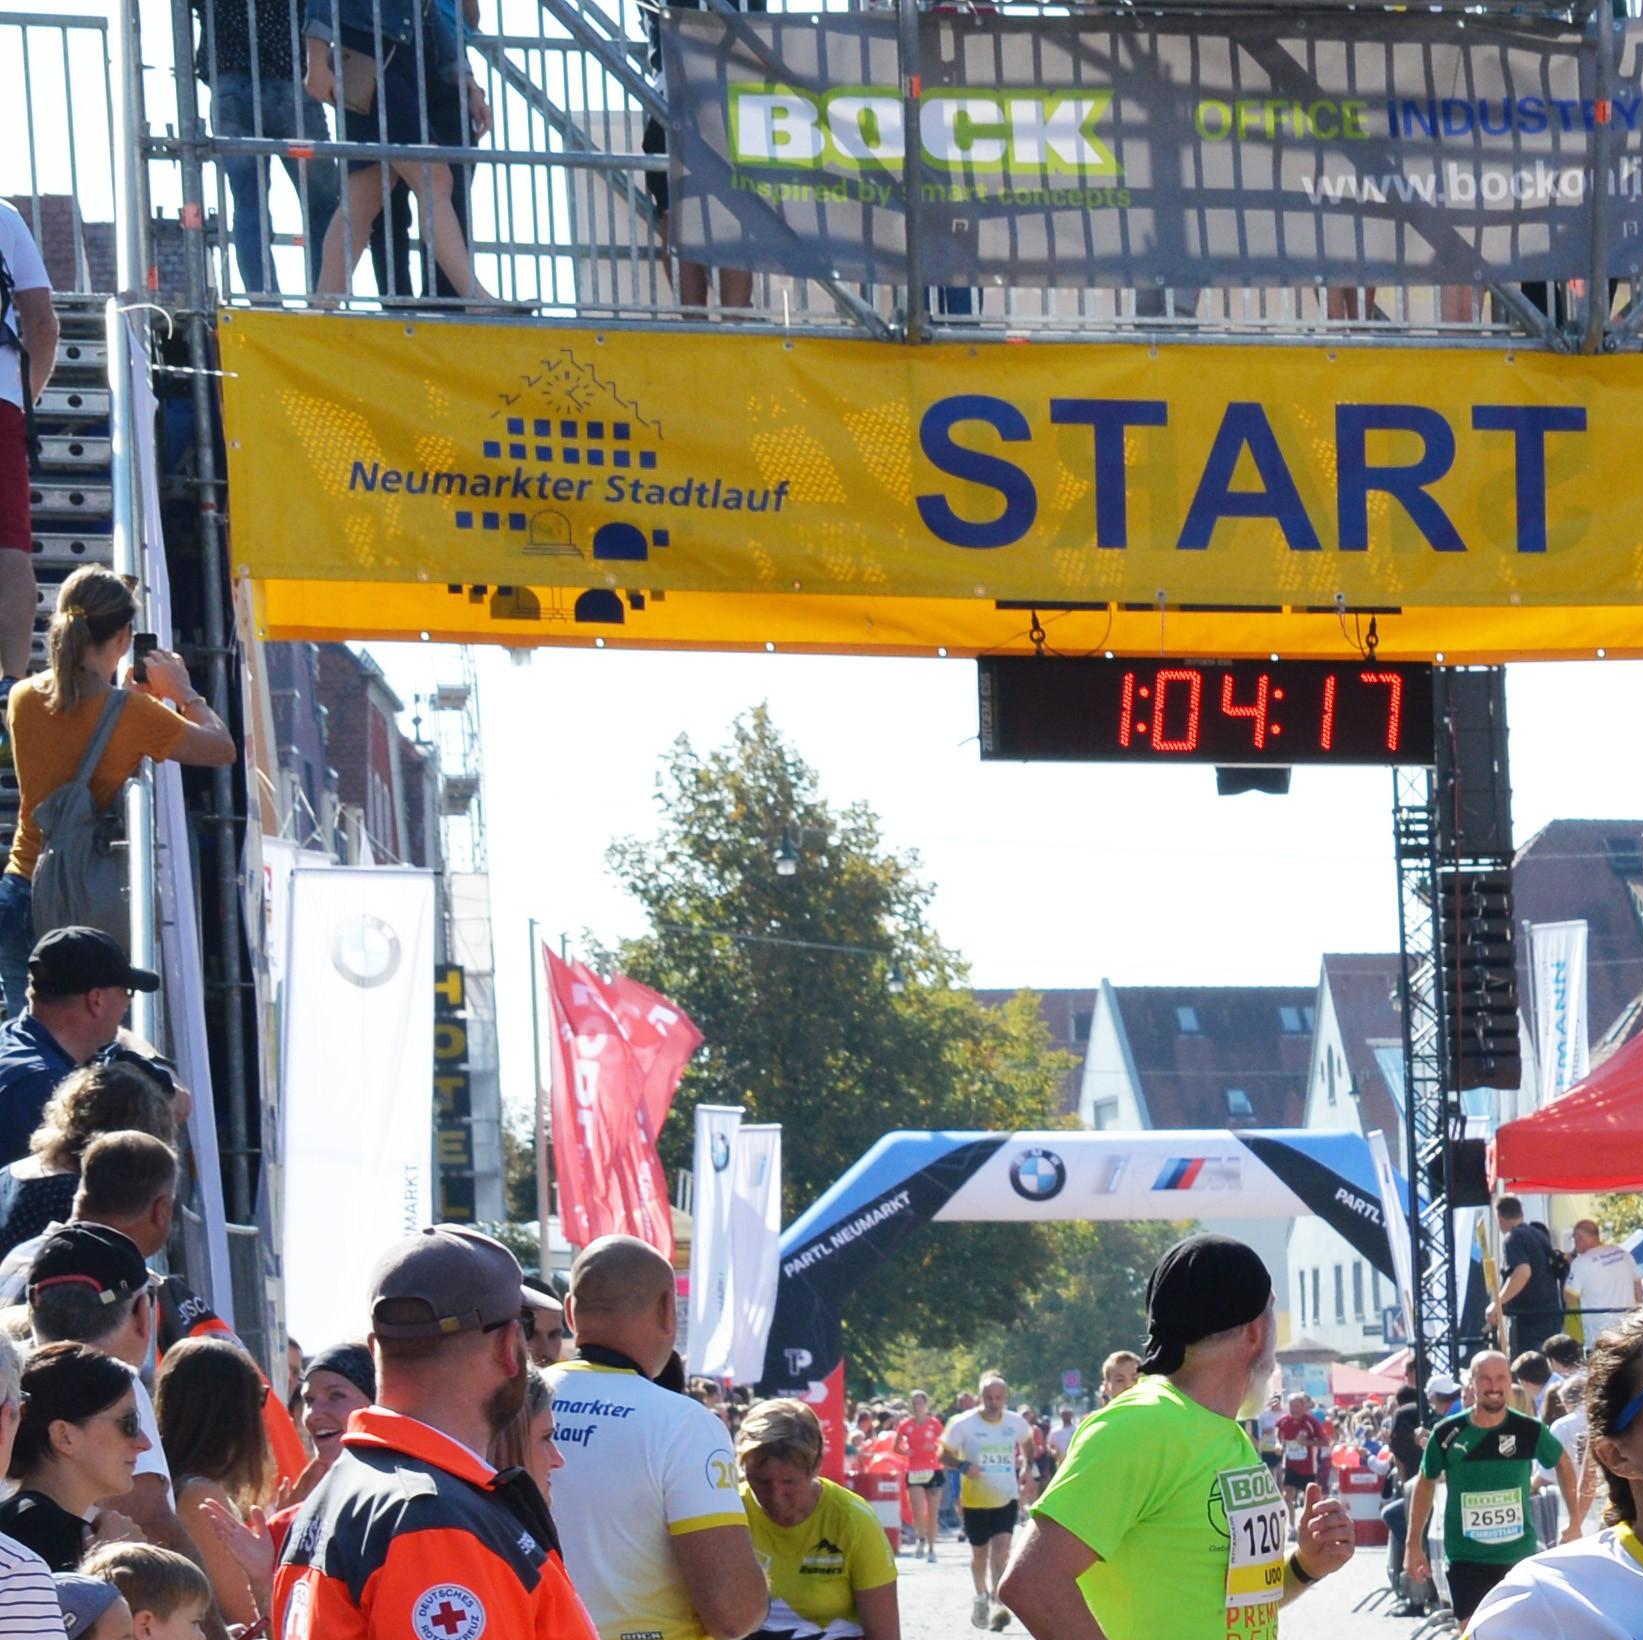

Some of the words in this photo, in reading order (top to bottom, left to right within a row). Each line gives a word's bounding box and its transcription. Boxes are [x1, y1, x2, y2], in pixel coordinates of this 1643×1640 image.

[737, 94, 1104, 164] BOCK
[1196, 99, 1369, 141] OFFICE
[731, 173, 847, 206] inspired
[858, 184, 890, 205] by
[901, 182, 988, 206] mart
[999, 183, 1132, 209] concepts
[349, 460, 592, 501] Neumarkter
[604, 473, 792, 513] Stadtlauf
[914, 394, 1588, 552] START
[1119, 669, 1402, 752] 1:04:17
[403, 1163, 419, 1237] MARKT
[1334, 1186, 1383, 1230] PARTL
[783, 1242, 833, 1279] PARTL
[829, 1189, 912, 1249] NEUMARKT
[551, 1399, 636, 1420] markter
[1232, 1473, 1275, 1501] BOC
[1470, 1507, 1517, 1527] 2659
[1264, 1566, 1282, 1586] UDO
[418, 1588, 474, 1618] DEUTSCHES
